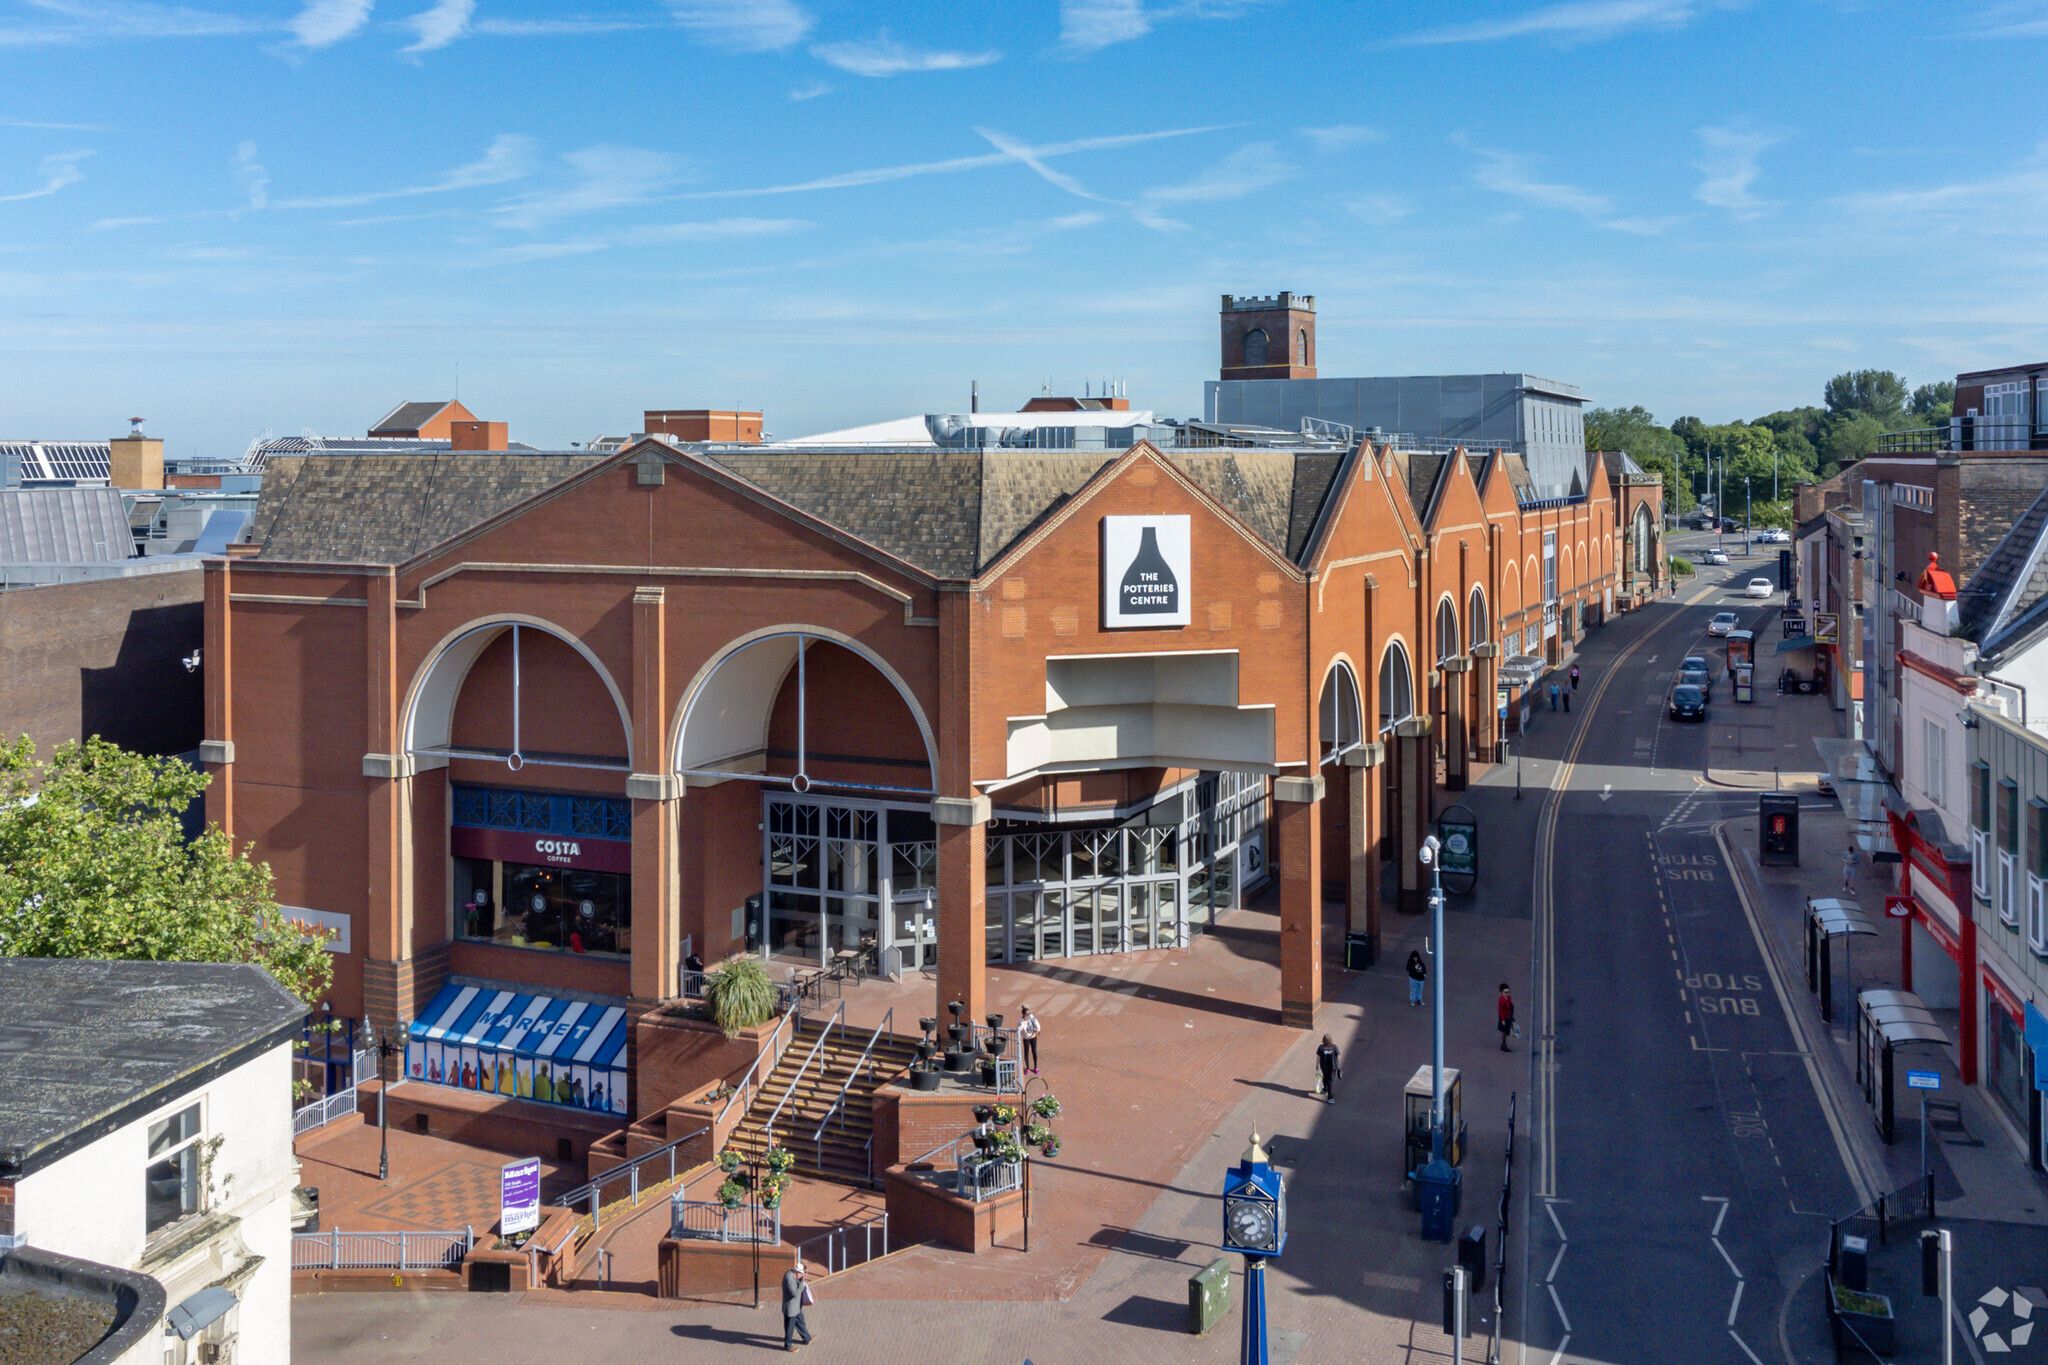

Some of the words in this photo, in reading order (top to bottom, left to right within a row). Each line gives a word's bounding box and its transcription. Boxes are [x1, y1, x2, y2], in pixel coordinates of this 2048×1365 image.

[1140, 573, 1159, 582] THE
[1123, 584, 1175, 594] POTTERIES
[1130, 596, 1168, 605] CENTRE
[535, 839, 580, 855] COSTA
[547, 855, 571, 863] COFFEE
[1657, 854, 1718, 866] STOP
[1667, 869, 1715, 881] BUS
[1685, 973, 1762, 991] STOP
[1700, 996, 1761, 1016] BUS
[478, 1011, 591, 1040] MARKET
[504, 1164, 538, 1180] Market
